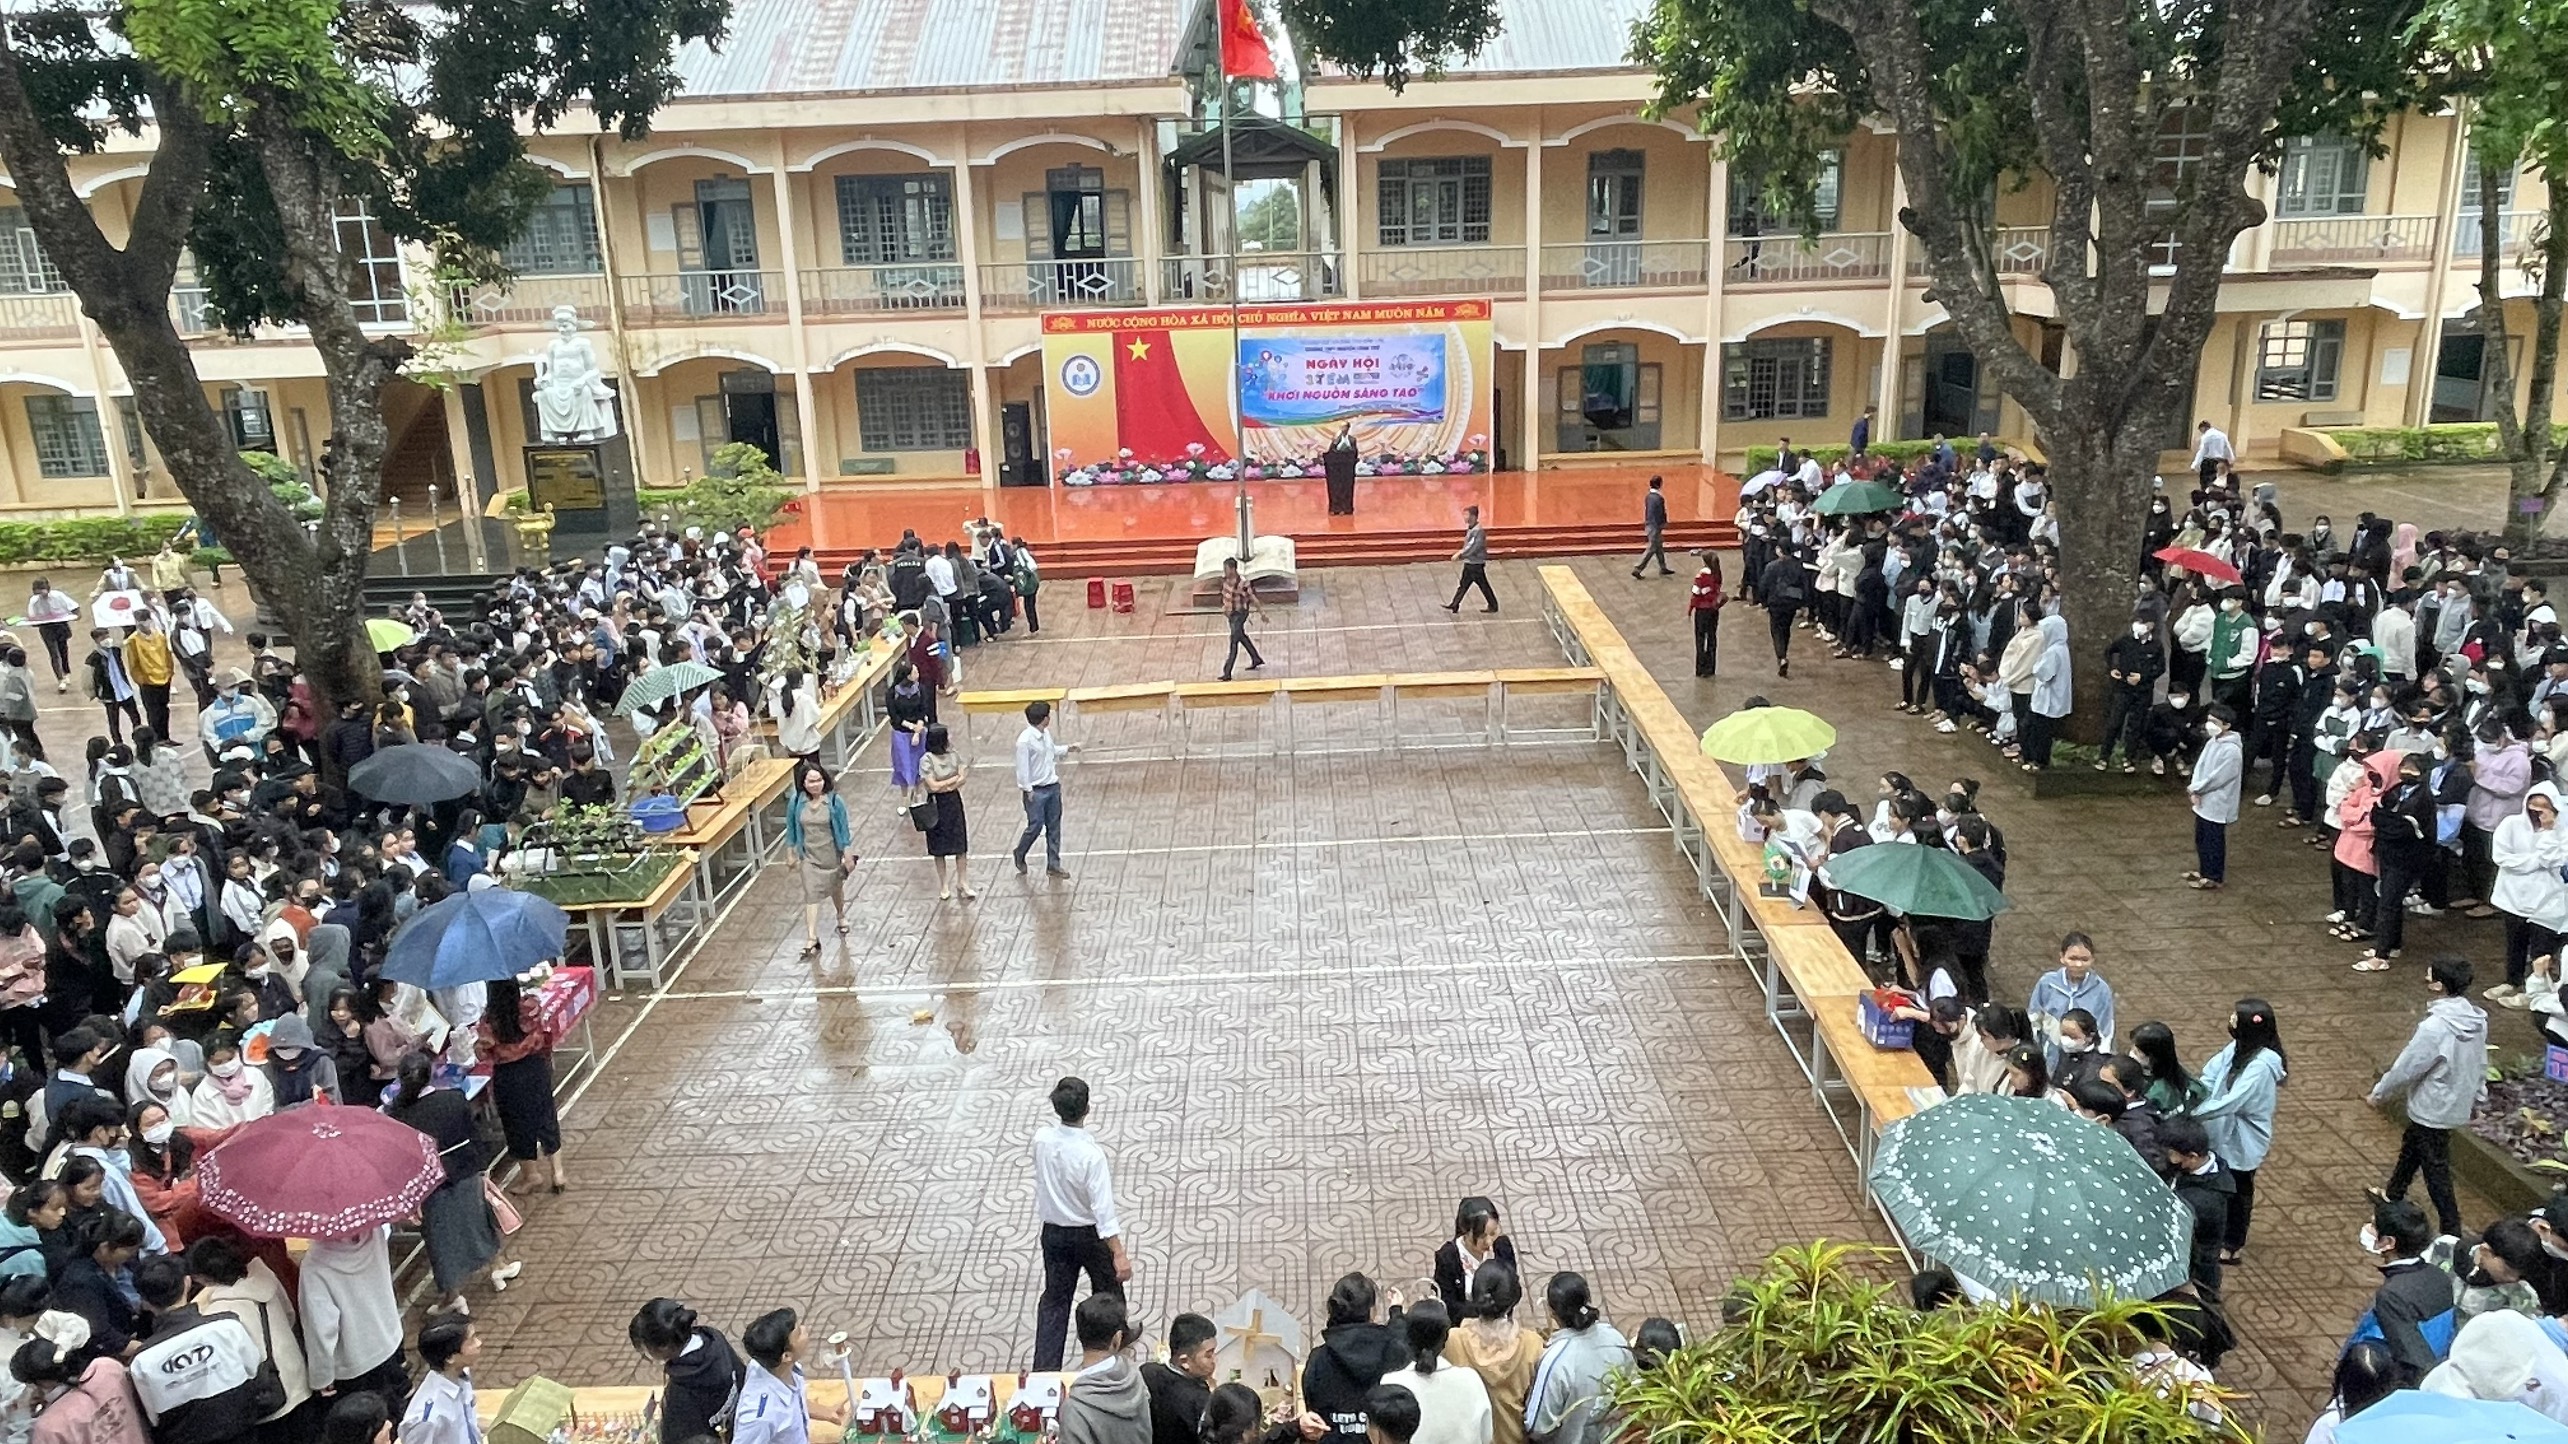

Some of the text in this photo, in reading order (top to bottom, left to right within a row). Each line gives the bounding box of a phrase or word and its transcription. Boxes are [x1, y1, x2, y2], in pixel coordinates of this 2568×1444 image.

[1087, 316, 1121, 328] NƯỚC
[1123, 315, 1157, 328] CỘNG
[1160, 313, 1187, 326] HÒA
[1212, 312, 1234, 325] HỘI
[1266, 310, 1307, 323] NGHĨA
[1310, 309, 1340, 323] VIỆT
[1342, 310, 1372, 321] NAM
[1375, 308, 1413, 319] MUÔN
[1306, 357, 1348, 369] NGÀY
[1353, 355, 1380, 371] HỘI
[1303, 386, 1350, 400] NGUỒN
[1353, 386, 1389, 399] SÁNG
